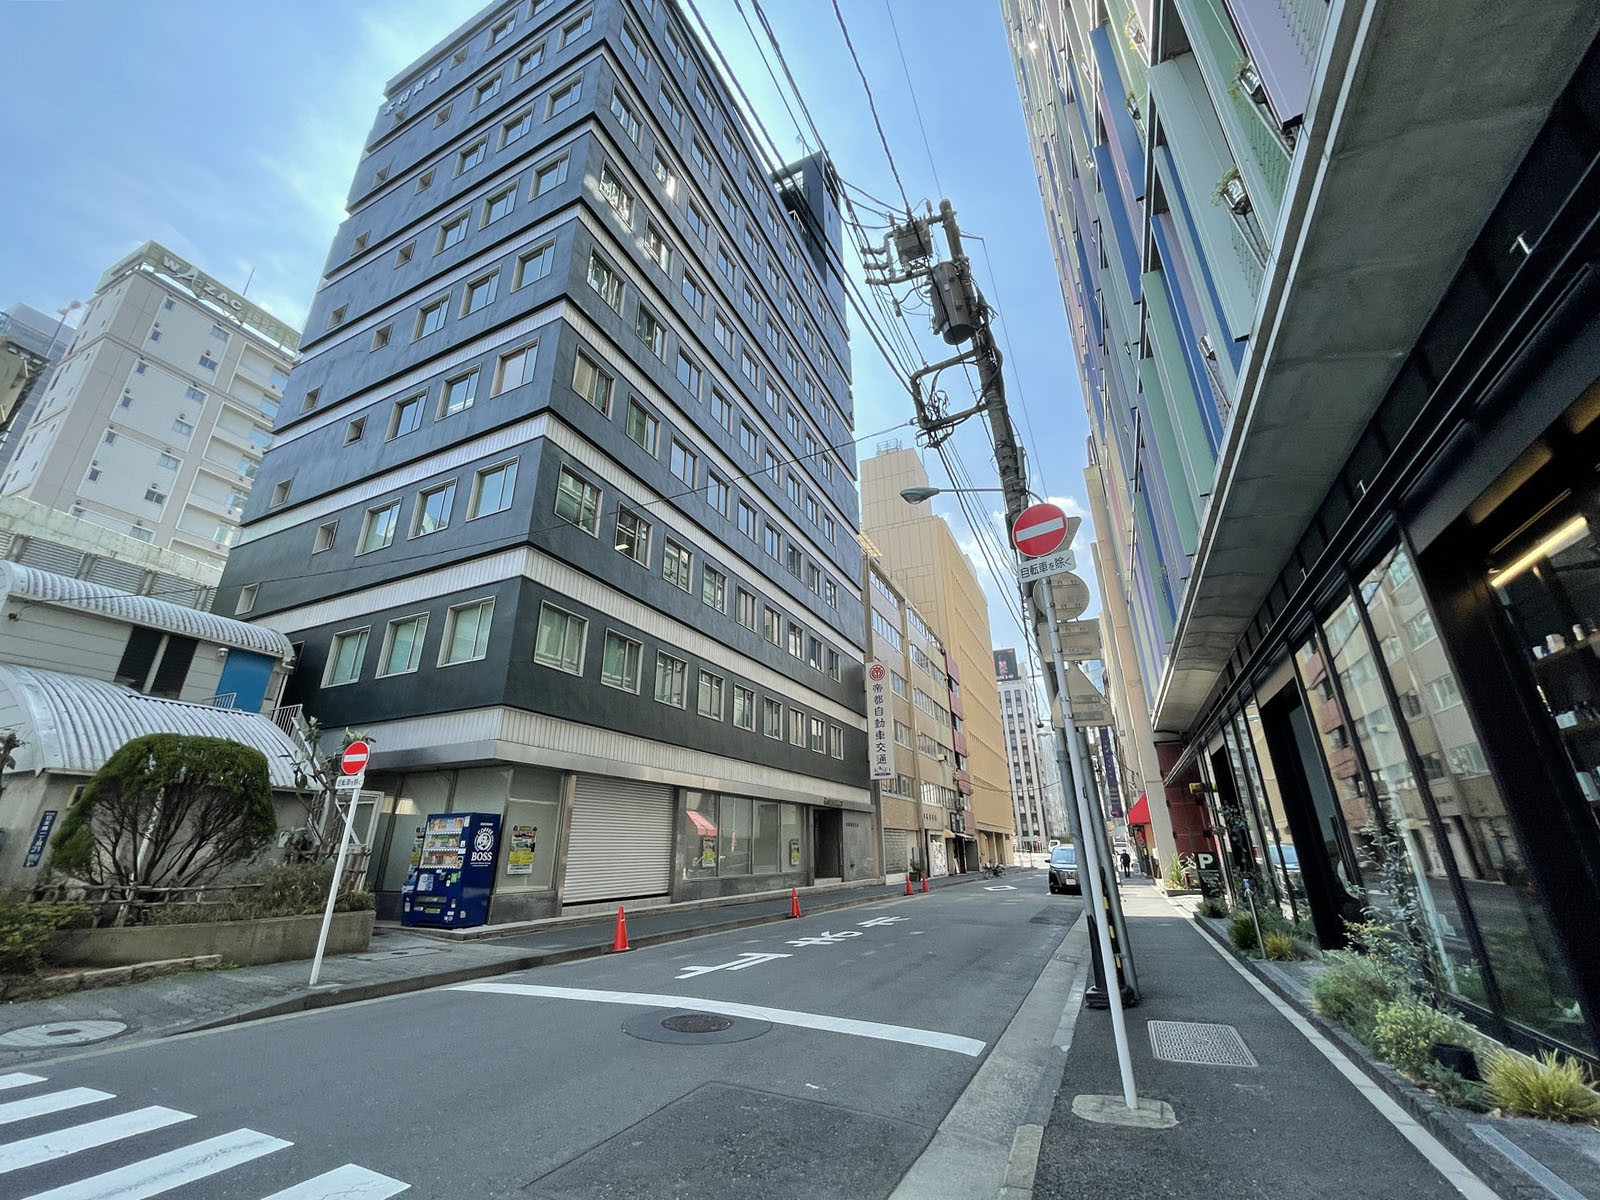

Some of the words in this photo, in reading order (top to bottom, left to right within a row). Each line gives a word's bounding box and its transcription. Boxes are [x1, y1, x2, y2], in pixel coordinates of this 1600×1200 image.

[1020, 556, 1072, 579] 自転車を除く
[872, 683, 887, 765] 帝都自動車交通
[477, 827, 494, 836] COFFEE
[471, 851, 493, 862] BOSS
[1197, 853, 1213, 869] P
[674, 915, 912, 980] 止まれ
